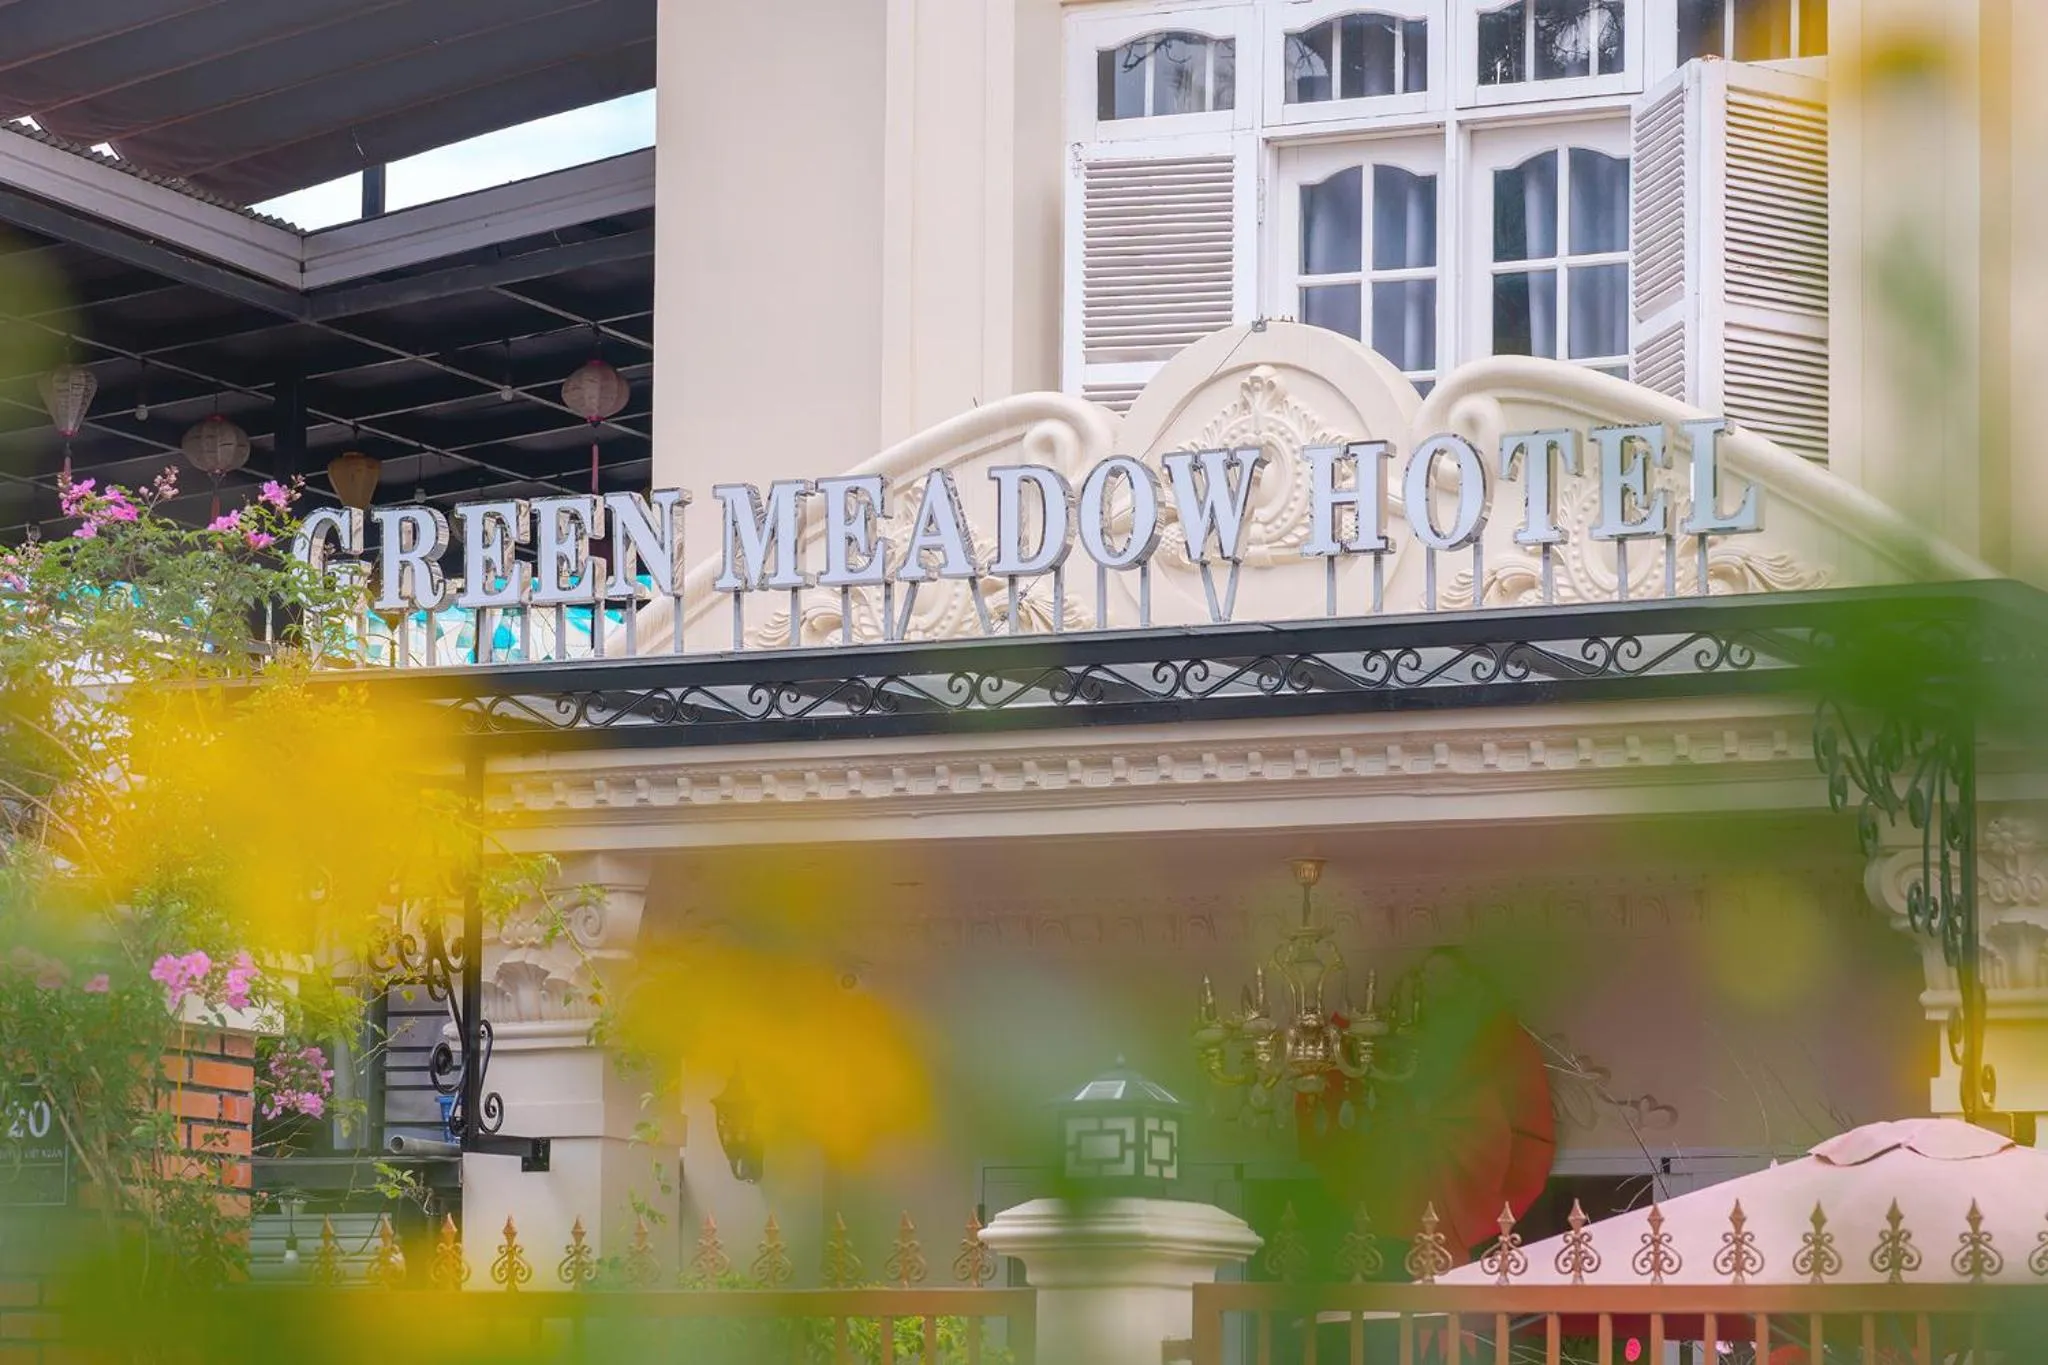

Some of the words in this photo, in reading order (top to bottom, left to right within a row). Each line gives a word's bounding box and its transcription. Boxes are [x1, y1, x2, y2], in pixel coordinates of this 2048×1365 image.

[291, 488, 691, 611] GREEN
[712, 445, 1269, 590] MEADOW
[1300, 418, 1764, 555] HOTEL
[5, 1100, 51, 1138] 20
